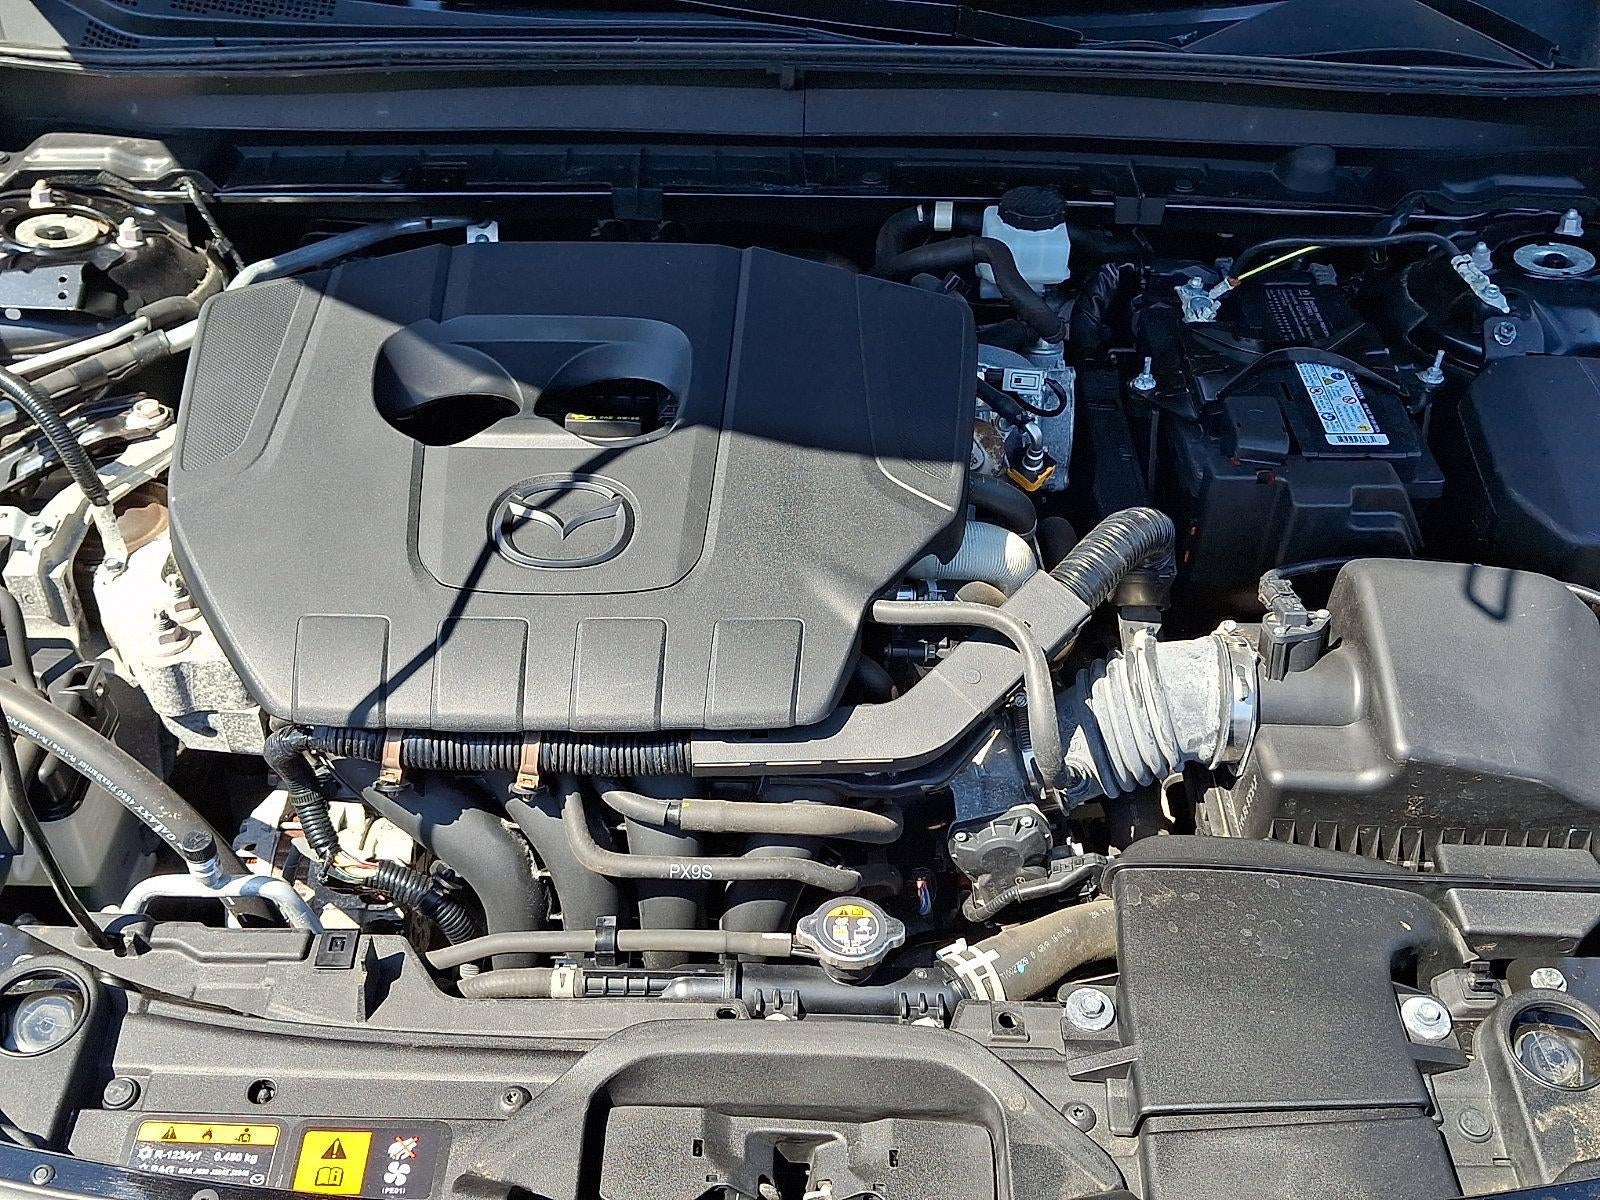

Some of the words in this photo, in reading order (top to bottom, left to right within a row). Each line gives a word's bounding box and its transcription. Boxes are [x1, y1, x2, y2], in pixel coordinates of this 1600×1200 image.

[134, 805, 176, 841] GALAXY
[670, 863, 713, 880] PX9S
[244, 1152, 259, 1165] kg
